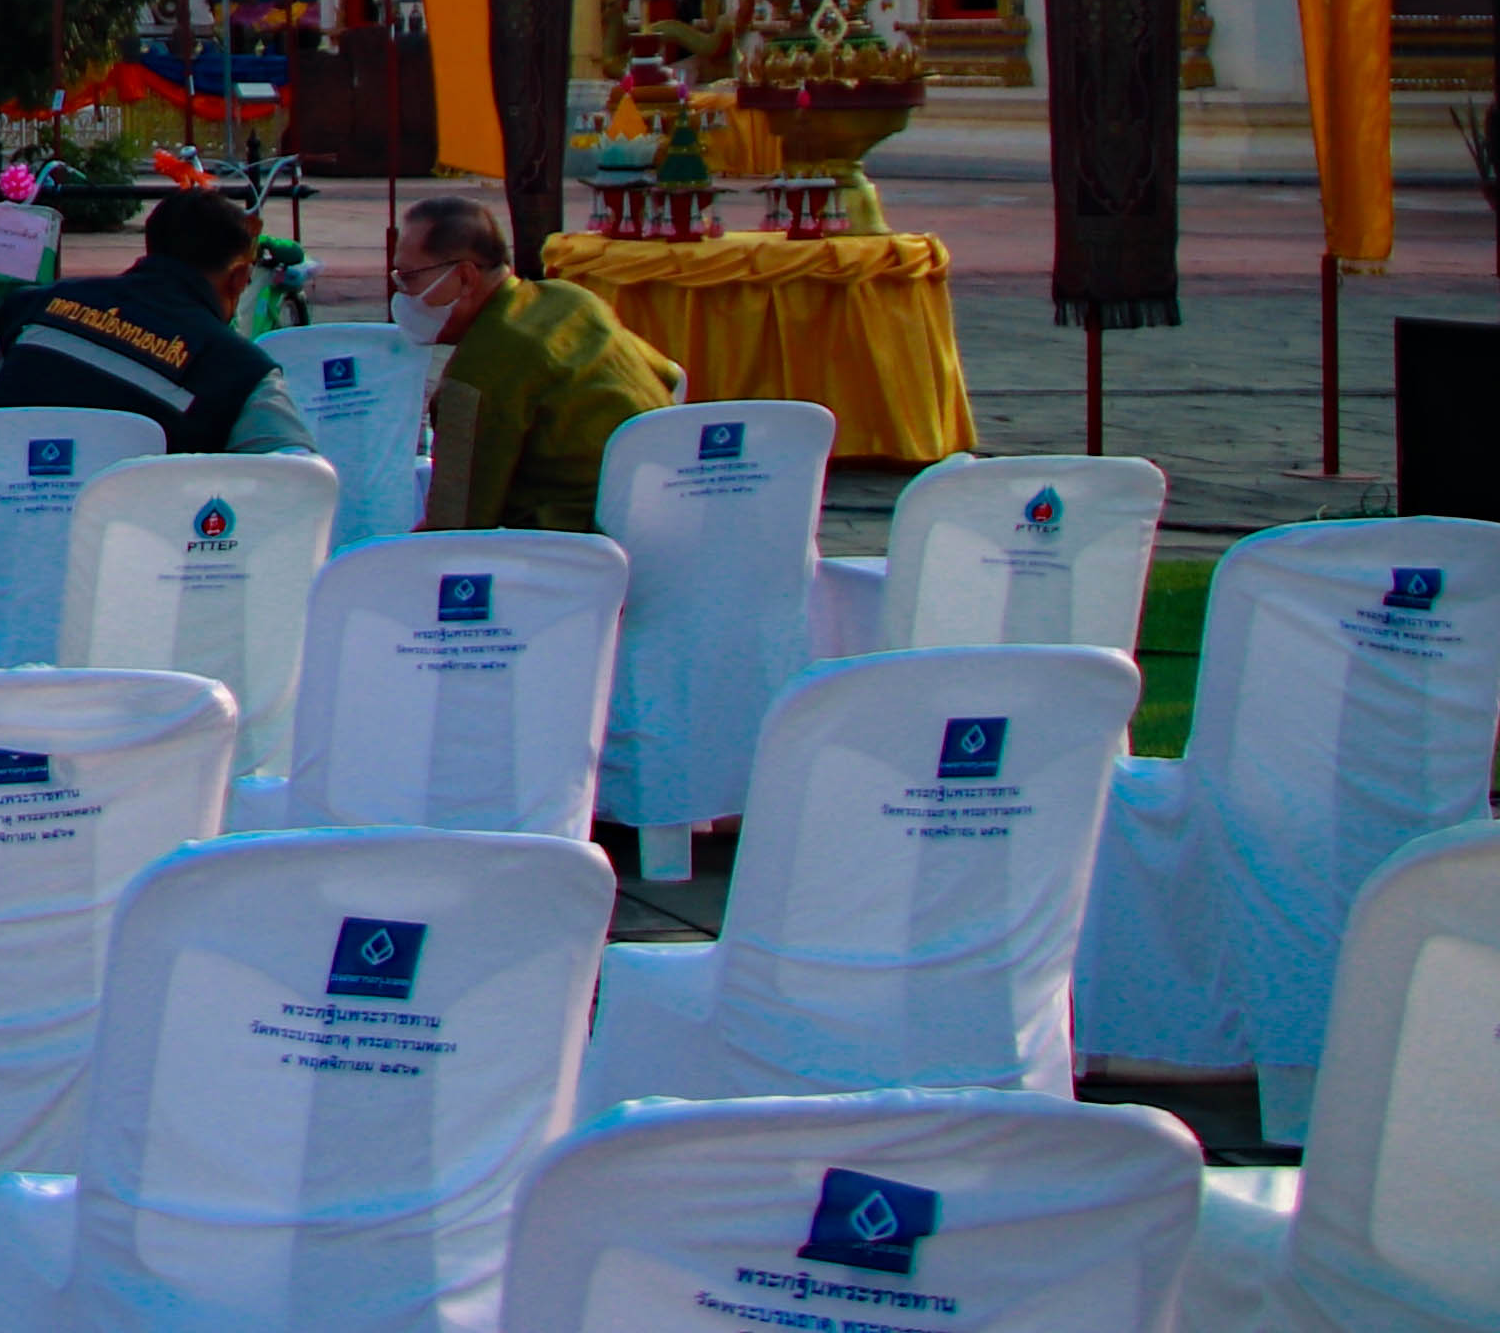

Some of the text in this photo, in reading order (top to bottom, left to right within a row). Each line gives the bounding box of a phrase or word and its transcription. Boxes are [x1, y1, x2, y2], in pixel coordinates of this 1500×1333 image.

[187, 540, 240, 552] PTTEP
[281, 1001, 441, 1030] พระกฐินพระราชทาน
[250, 1020, 457, 1053] วัดพระบรมธาตุ พระอารามหลวง
[736, 1266, 957, 1315] พระกฐินพระราชทาน
